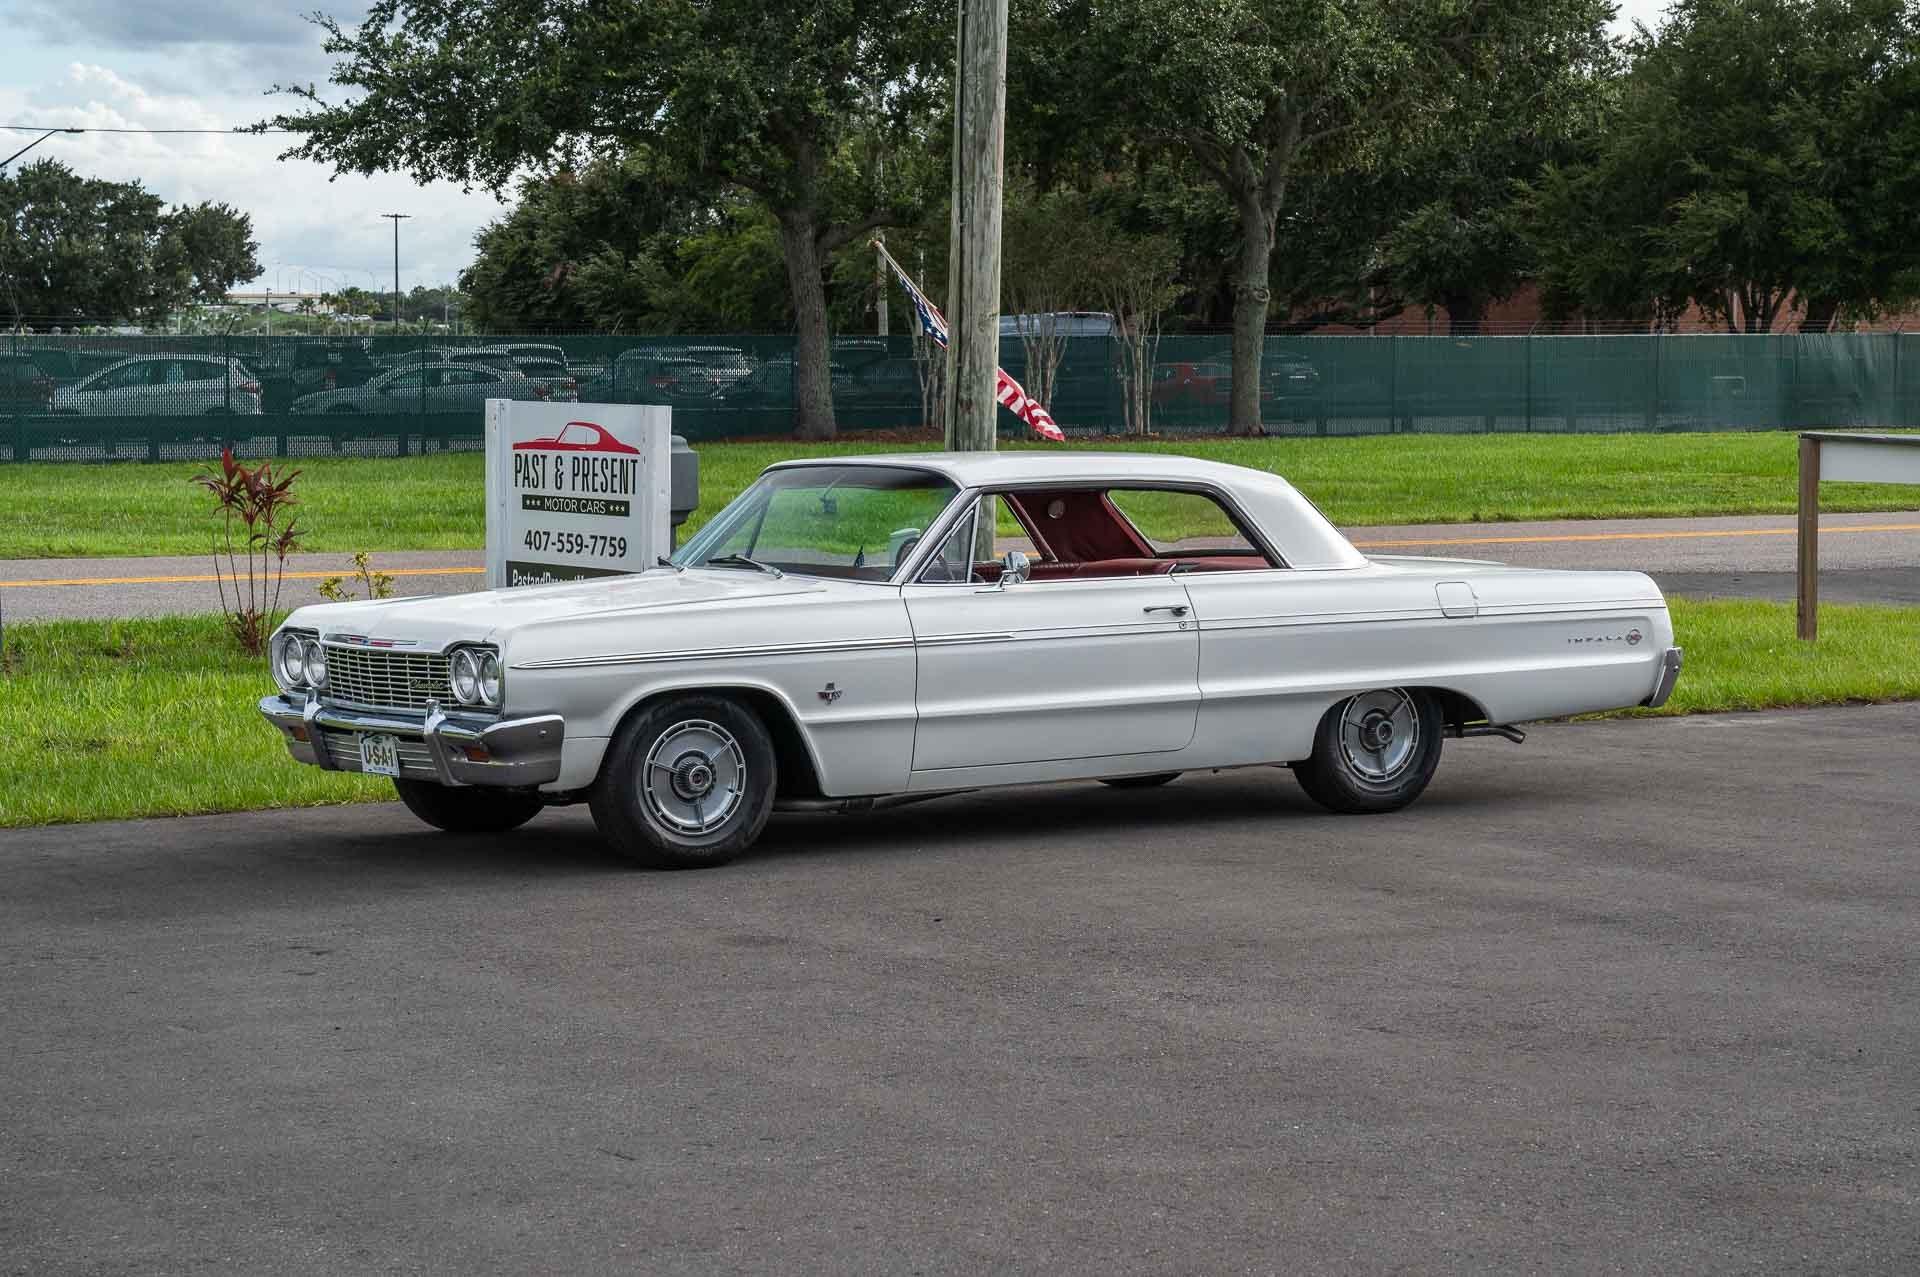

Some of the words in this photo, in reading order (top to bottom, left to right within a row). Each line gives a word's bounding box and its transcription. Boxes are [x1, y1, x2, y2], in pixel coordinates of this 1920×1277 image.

[514, 453, 547, 489] PAST
[554, 455, 564, 490] &
[572, 456, 638, 495] PRESENT
[544, 499, 577, 513] MOTOR
[580, 501, 606, 514] CARS
[524, 530, 627, 558] 407-559-7759
